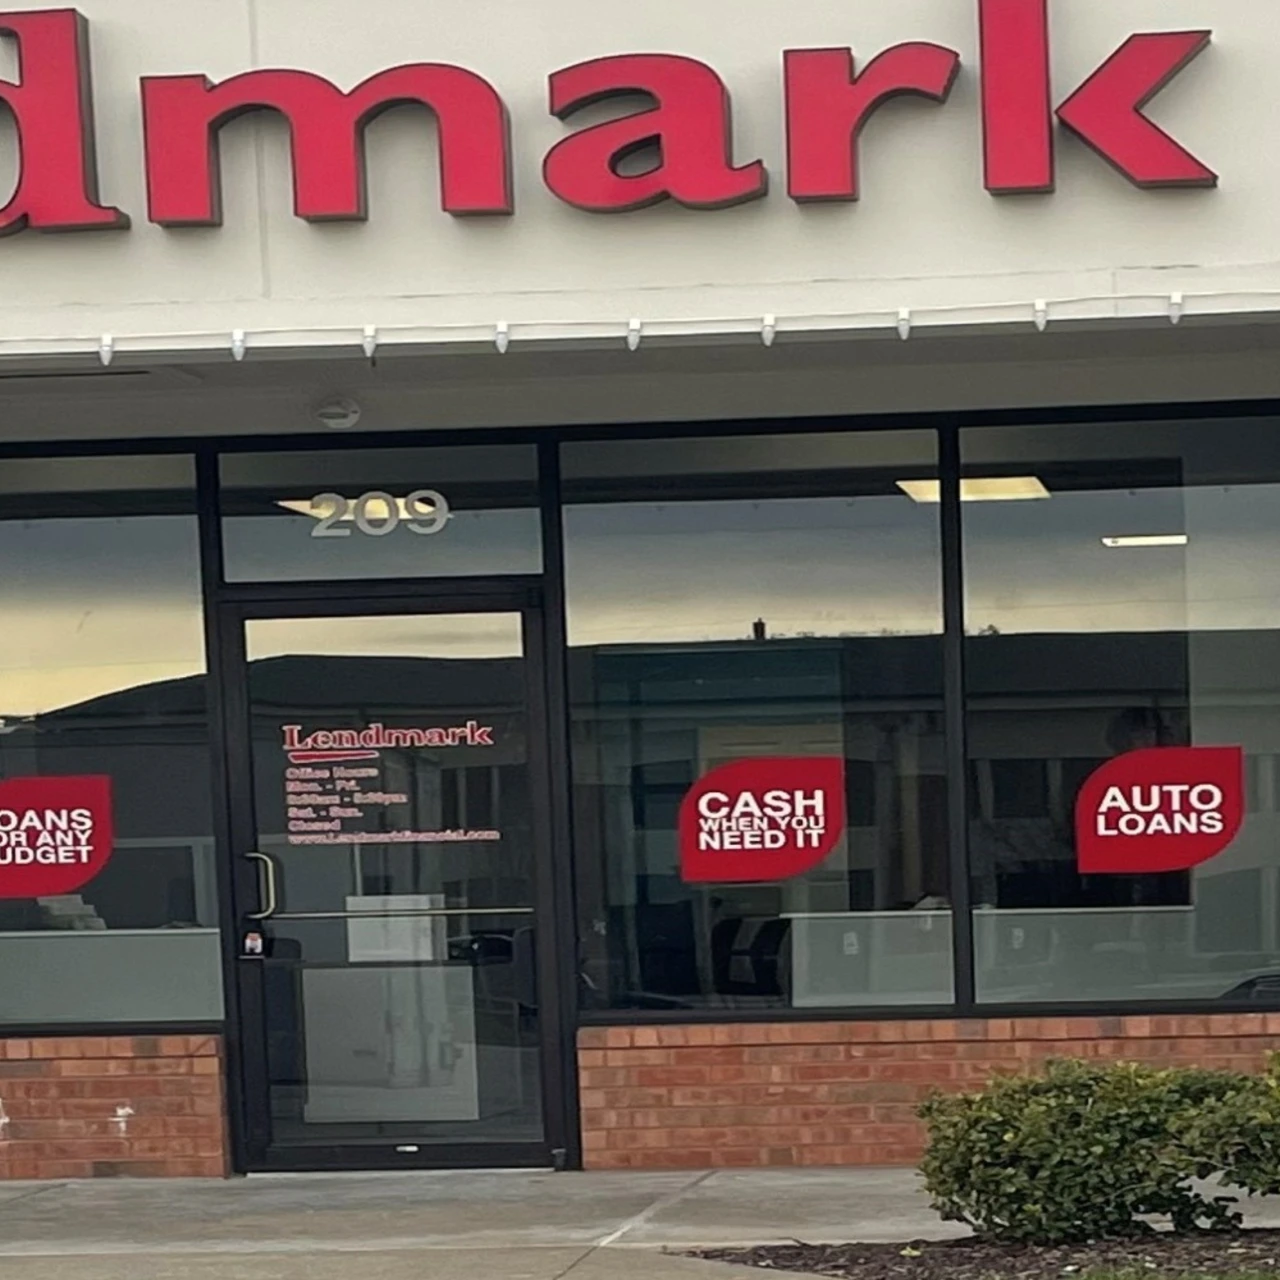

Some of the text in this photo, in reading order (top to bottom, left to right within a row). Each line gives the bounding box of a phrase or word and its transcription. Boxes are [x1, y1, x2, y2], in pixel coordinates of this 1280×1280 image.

[310, 489, 449, 537] 209
[282, 720, 495, 751] Lendmark
[698, 789, 824, 818] CASH
[1097, 783, 1223, 813] AUTO
[699, 815, 825, 832] WHEN YOU
[1097, 811, 1224, 836] LOANS
[35, 829, 93, 846] ANY
[699, 829, 825, 851] NEED IT
